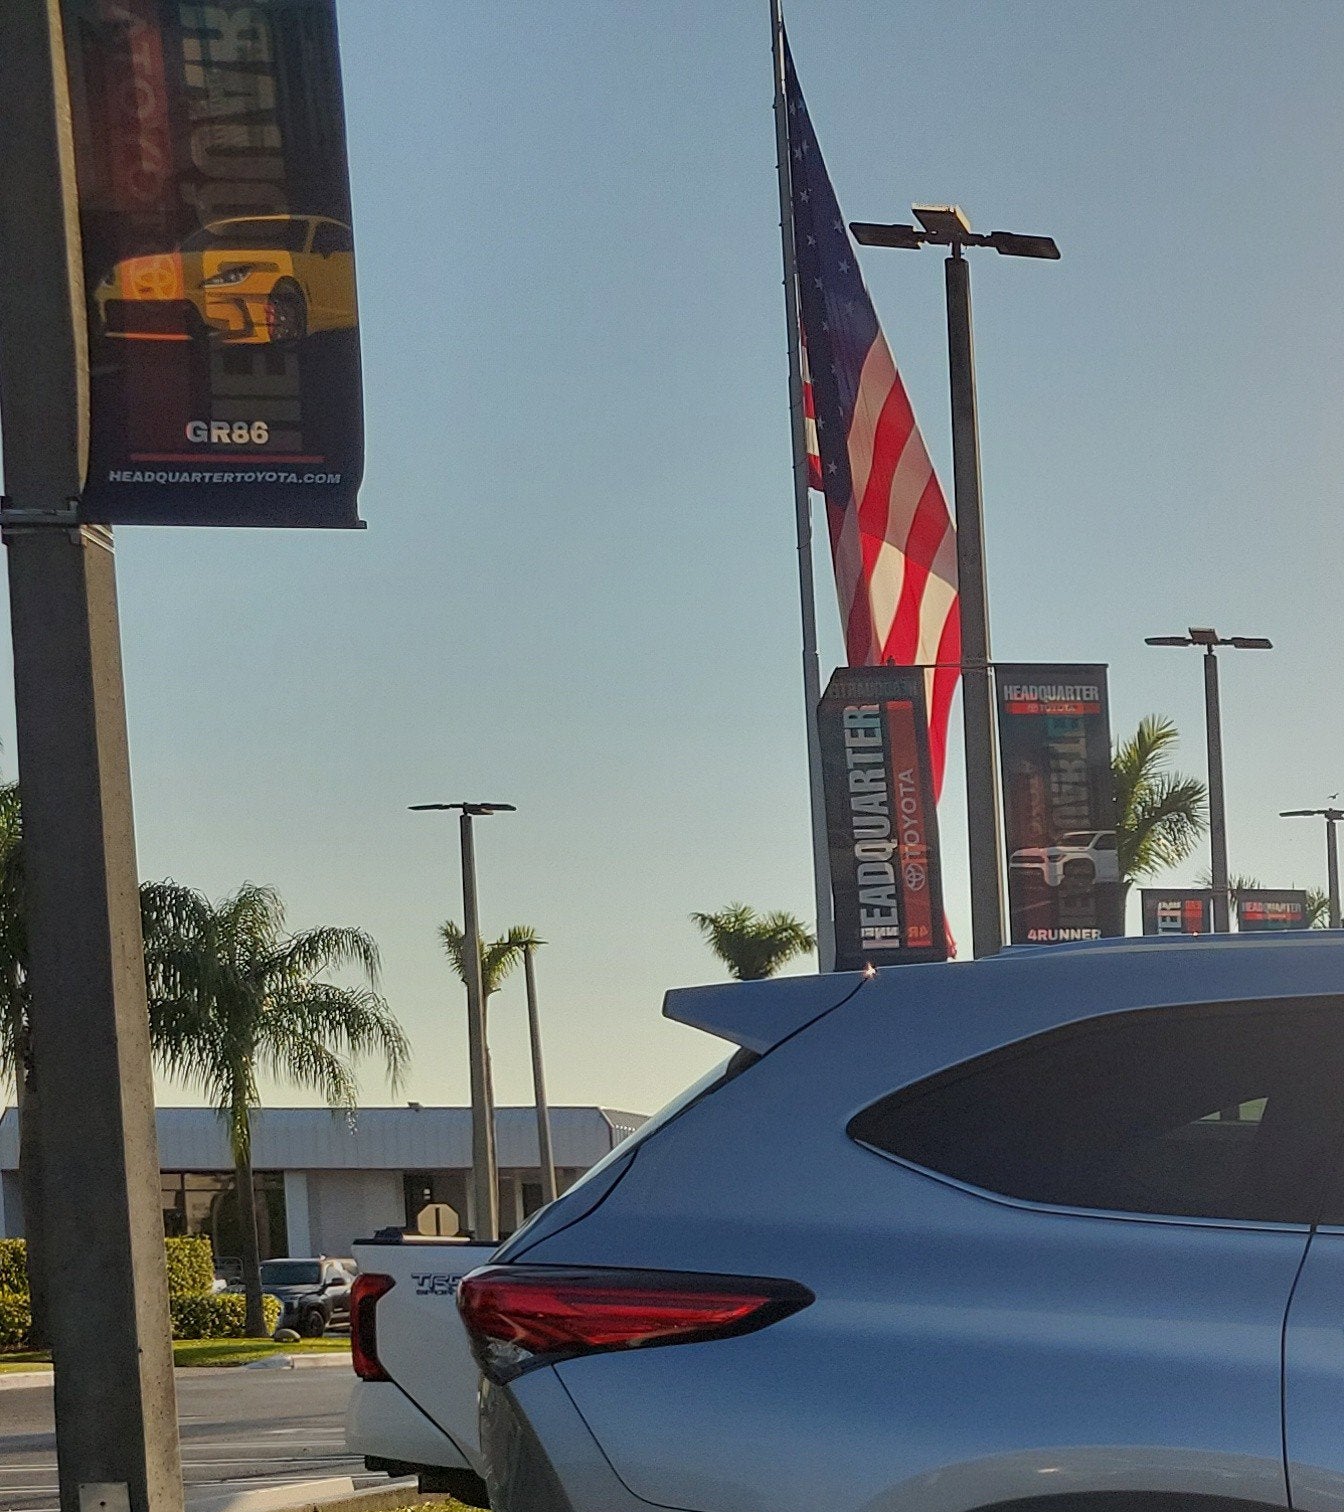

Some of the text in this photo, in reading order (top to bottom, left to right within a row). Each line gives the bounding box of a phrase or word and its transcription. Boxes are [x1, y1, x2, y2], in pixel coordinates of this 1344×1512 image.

[185, 421, 269, 444] GR86
[109, 470, 341, 485] HEADQUARTERTOYOTA.COM
[1003, 685, 1099, 702] HEADQUARTER
[898, 768, 922, 861] TOYOTA
[842, 703, 901, 950] HEADQUARTER
[1027, 928, 1102, 941] 4RUNNER
